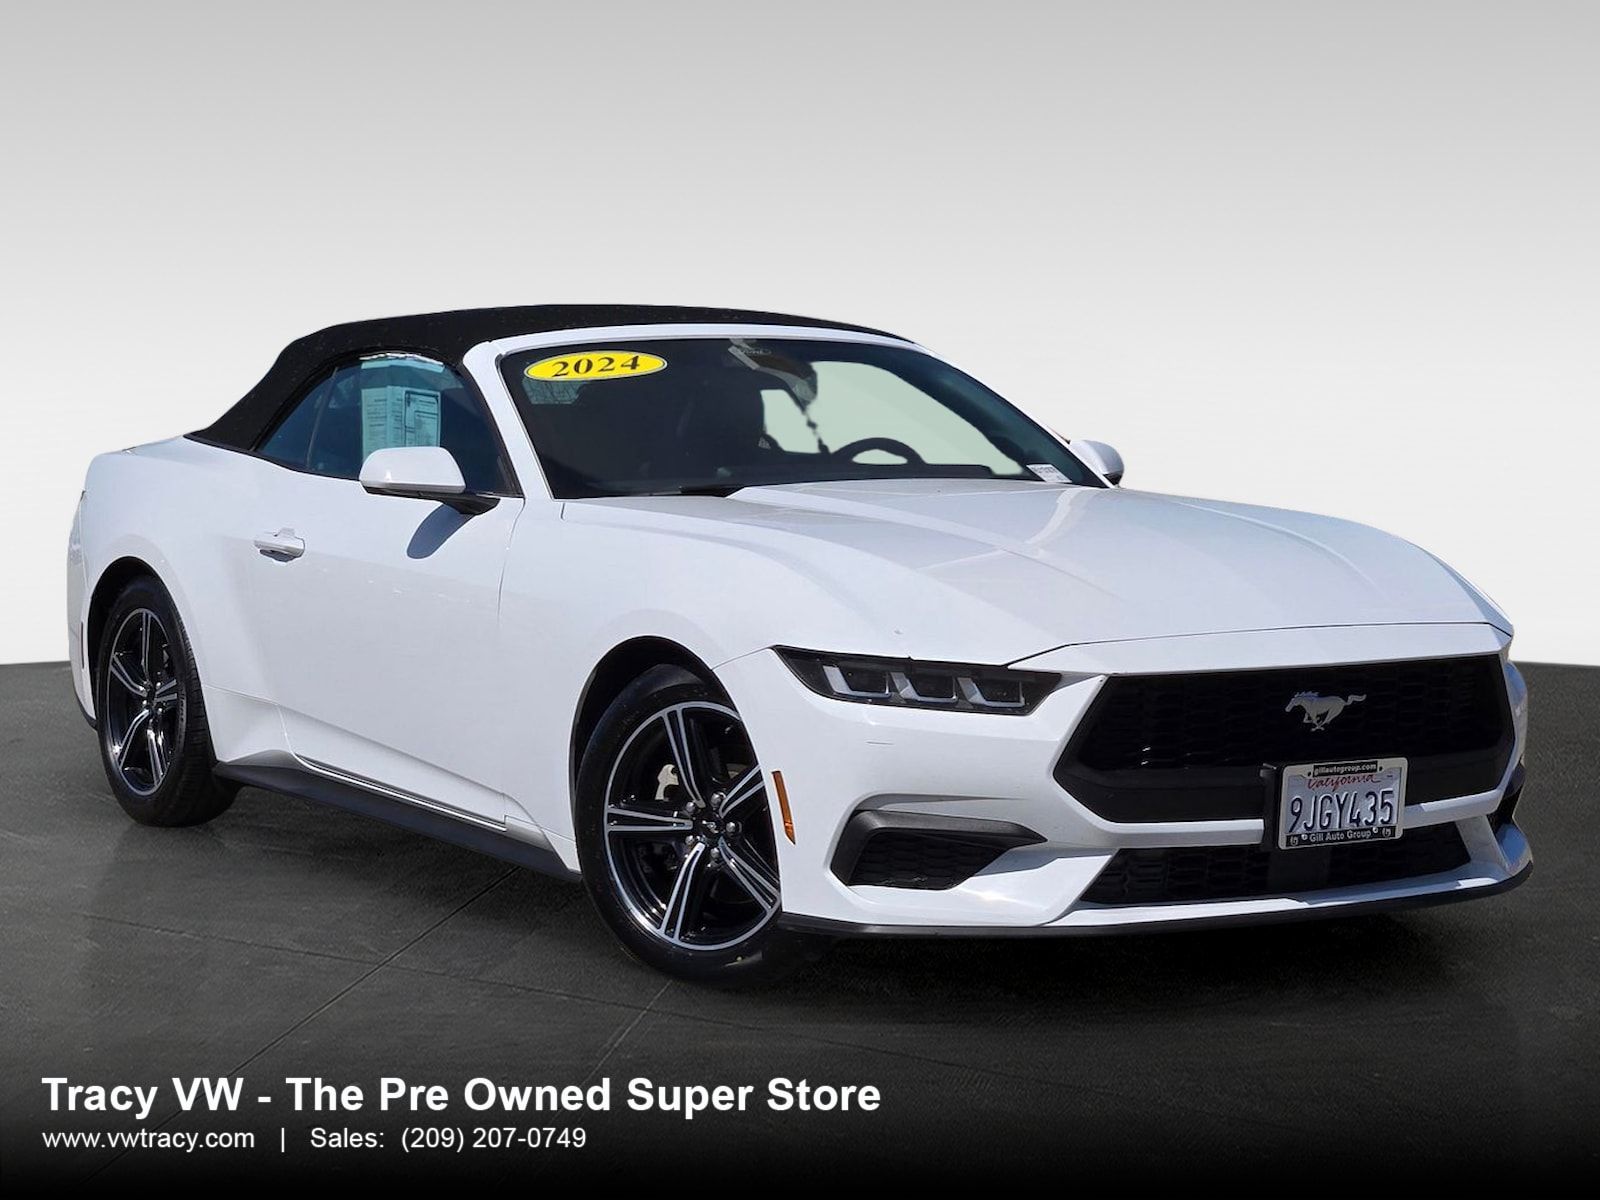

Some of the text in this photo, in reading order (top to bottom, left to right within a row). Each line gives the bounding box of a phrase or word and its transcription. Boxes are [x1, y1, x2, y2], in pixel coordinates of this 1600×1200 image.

[551, 355, 640, 378] 2024
[1313, 763, 1377, 776] gillautogroup.com
[1307, 773, 1382, 791] California
[1288, 788, 1394, 833] 9JGY435
[1309, 833, 1324, 842] Gill
[1325, 832, 1345, 841] Auto
[1347, 829, 1372, 840] Group
